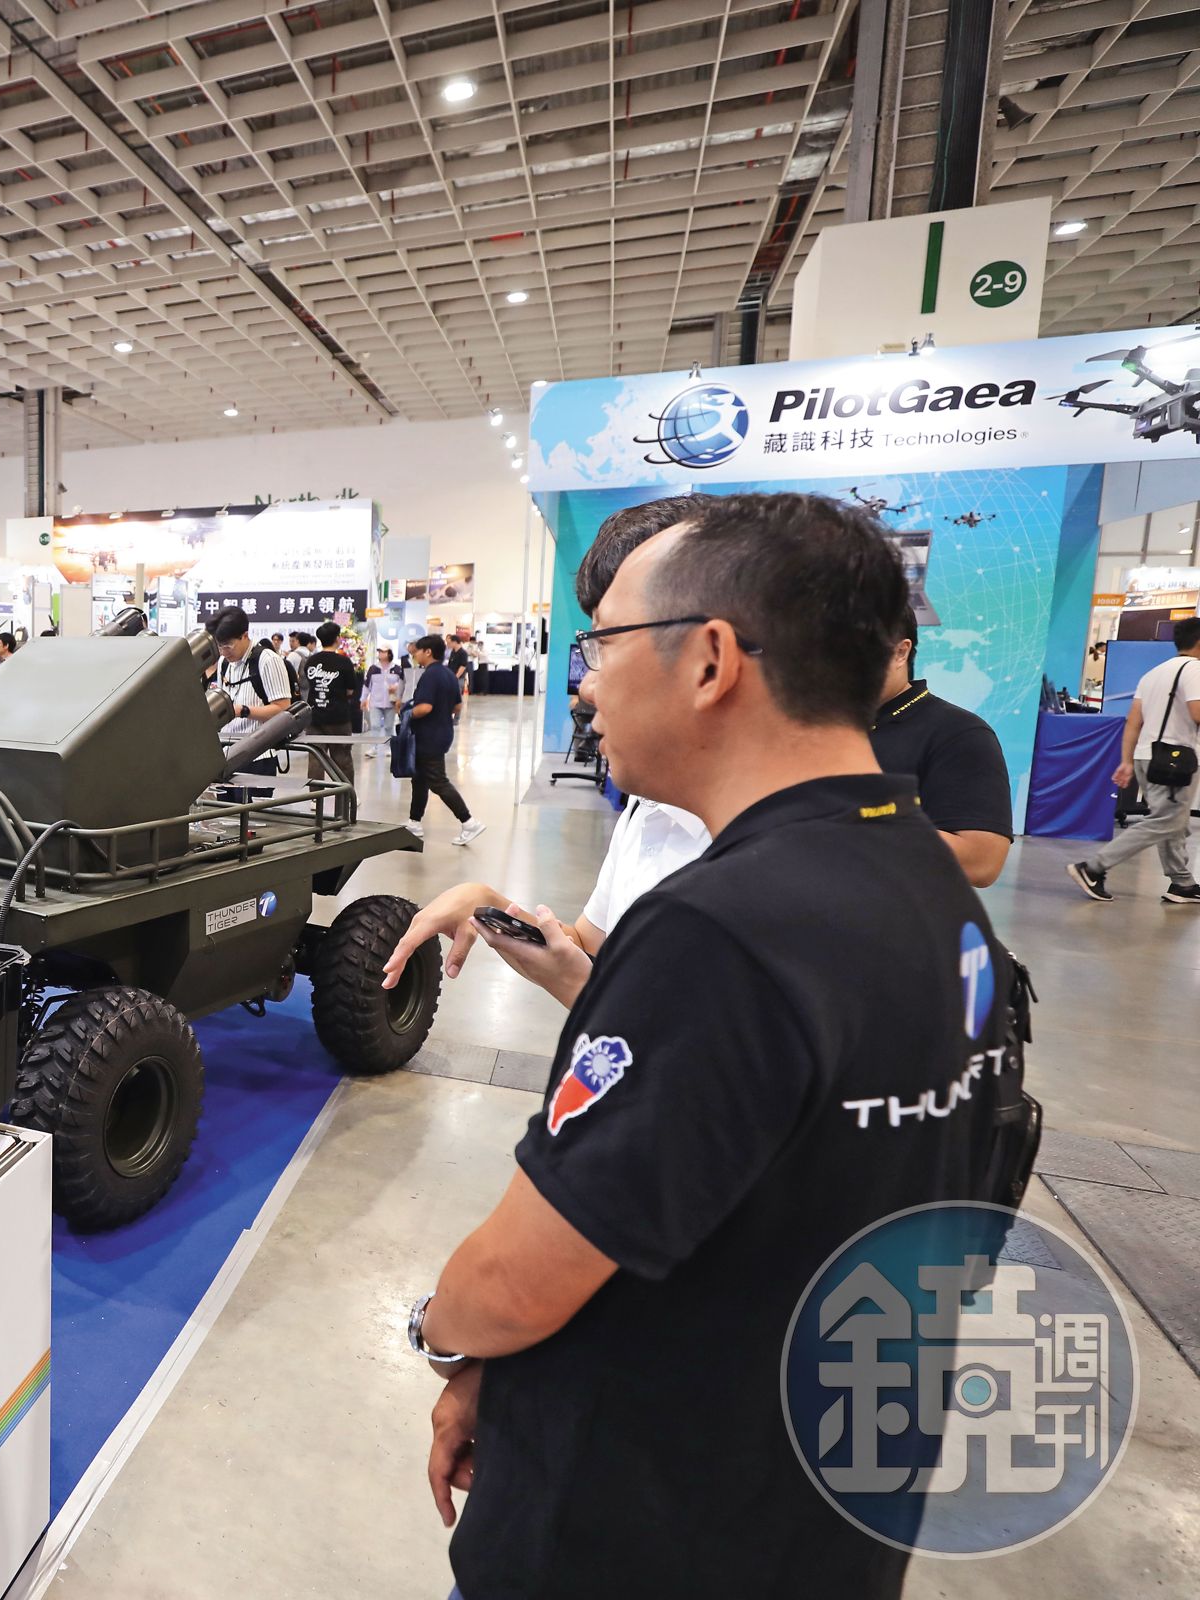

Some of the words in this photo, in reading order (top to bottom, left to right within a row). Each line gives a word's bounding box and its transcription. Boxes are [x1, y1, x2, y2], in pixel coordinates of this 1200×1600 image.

[974, 270, 1022, 297] 2-9
[769, 379, 1037, 423] PilotGaea
[763, 427, 874, 454] 藏識科技
[882, 427, 1018, 447] Technologies
[207, 900, 256, 922] THUNDER
[207, 916, 238, 932] TIGER
